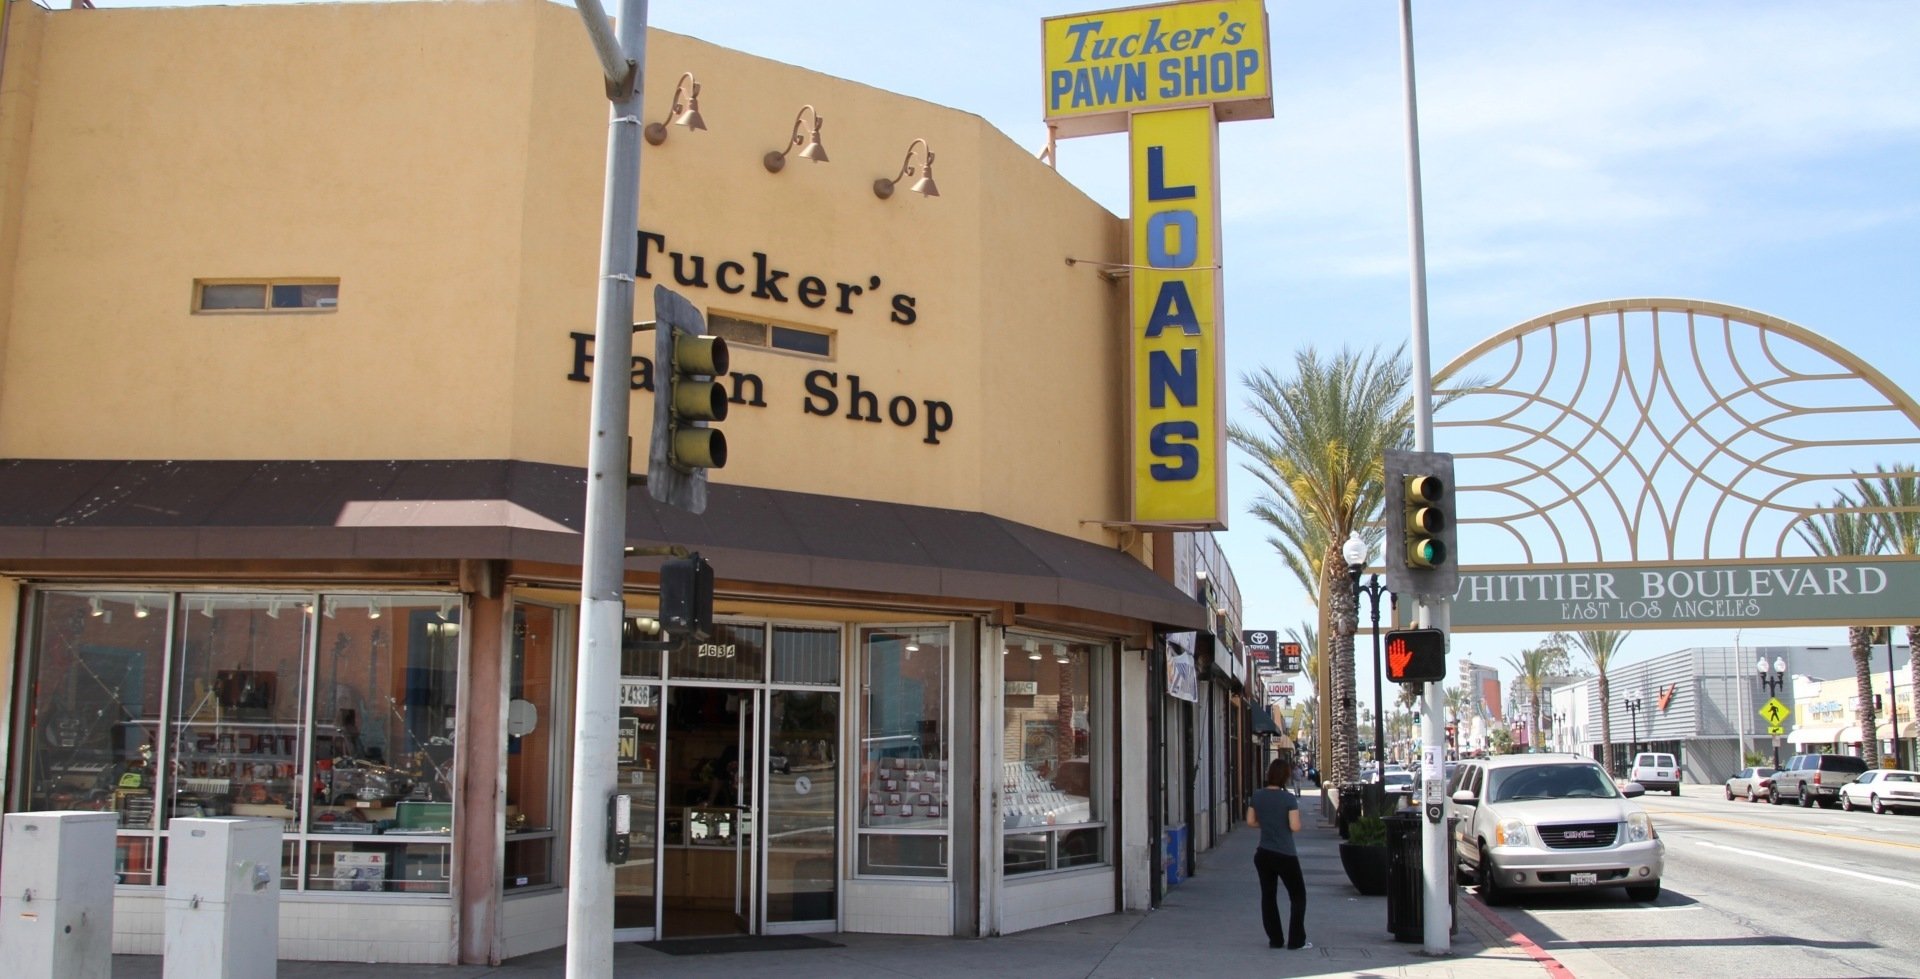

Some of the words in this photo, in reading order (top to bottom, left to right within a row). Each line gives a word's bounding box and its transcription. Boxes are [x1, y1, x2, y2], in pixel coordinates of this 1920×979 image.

[1065, 12, 1246, 63] Tucker's
[1051, 62, 1147, 110] PAWN
[1159, 49, 1259, 99] SHOP
[635, 230, 917, 326] Tucker's
[1145, 146, 1202, 482] LOANS
[567, 331, 768, 408] Pan
[804, 369, 954, 445] Shop
[1640, 567, 1887, 599] BOULEVARD
[1561, 602, 1610, 620] EAST
[1619, 601, 1662, 619] LOS
[1672, 598, 1760, 618] ANGELES
[699, 644, 735, 657] 4634
[1269, 685, 1293, 693] LIQUOR
[1563, 830, 1595, 839] GMC
